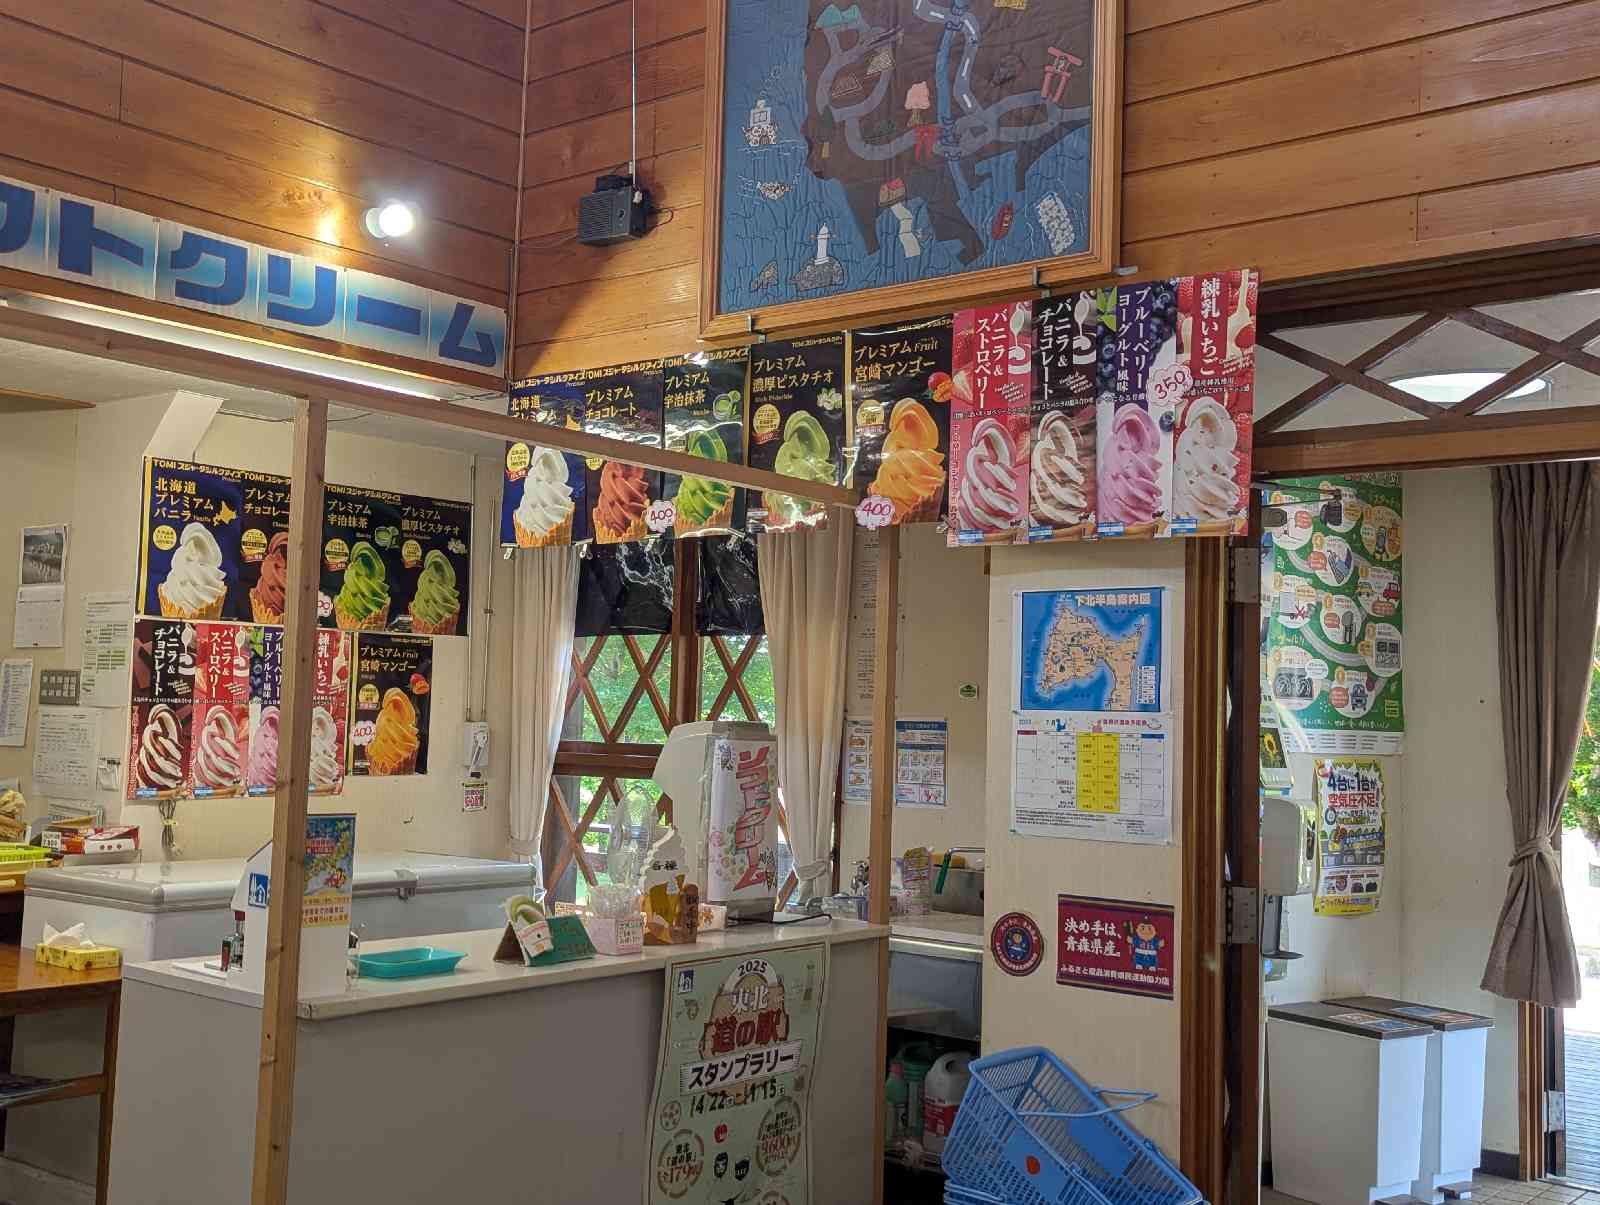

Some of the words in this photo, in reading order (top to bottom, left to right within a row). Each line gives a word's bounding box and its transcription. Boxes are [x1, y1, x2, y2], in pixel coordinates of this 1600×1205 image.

[1055, 299, 1072, 368] バニラ&
[1200, 277, 1220, 376] 練乳いちご
[991, 309, 1008, 376] バニラ&
[1116, 294, 1130, 392] ヨーグルト風味
[1134, 286, 1152, 390] ブルーベリー
[855, 341, 912, 361] プレミアム
[1038, 309, 1056, 400] チョコレート
[753, 355, 806, 373] プレミアム
[855, 356, 936, 382] 宮崎マンゴー
[974, 319, 994, 408] ストロベリー
[665, 371, 710, 391] プレミアム
[752, 370, 834, 392] 濃厚ピスタチオ
[1155, 371, 1185, 399] 350
[512, 395, 541, 411] 北海道
[585, 385, 634, 403] プレミアム
[664, 390, 706, 408] 宇治抹茶
[585, 402, 637, 420] チョコレート
[154, 459, 176, 469] TOMI
[156, 477, 197, 494] 北海道
[244, 472, 264, 482] TOMI
[156, 494, 214, 511] プレミアム
[244, 503, 290, 517] チョコレー
[328, 500, 372, 514] プレミアム
[862, 502, 891, 517] 400
[154, 507, 192, 522] バニラ
[327, 515, 368, 529] 宇治抹茶
[402, 507, 441, 520] プレミアム
[650, 507, 673, 522] 400
[402, 519, 461, 536] 濃厚ピスタチオ
[167, 624, 180, 674] バニラ&
[221, 627, 233, 676] バニラ&
[361, 645, 400, 658] プレミアム
[154, 627, 166, 696] チョコレート
[208, 632, 221, 698] ストロベリー
[262, 632, 272, 698] ヨーグルト風味
[316, 632, 330, 694] 練乳いちご
[360, 661, 416, 673] 宮崎マンゴー
[353, 724, 373, 737] 400
[1064, 917, 1122, 939] 決め手は、
[1064, 936, 1121, 957] 青森県産。
[738, 960, 768, 976] 2025
[731, 986, 769, 1014] 東北
[689, 1049, 794, 1089] スタンプラリー
